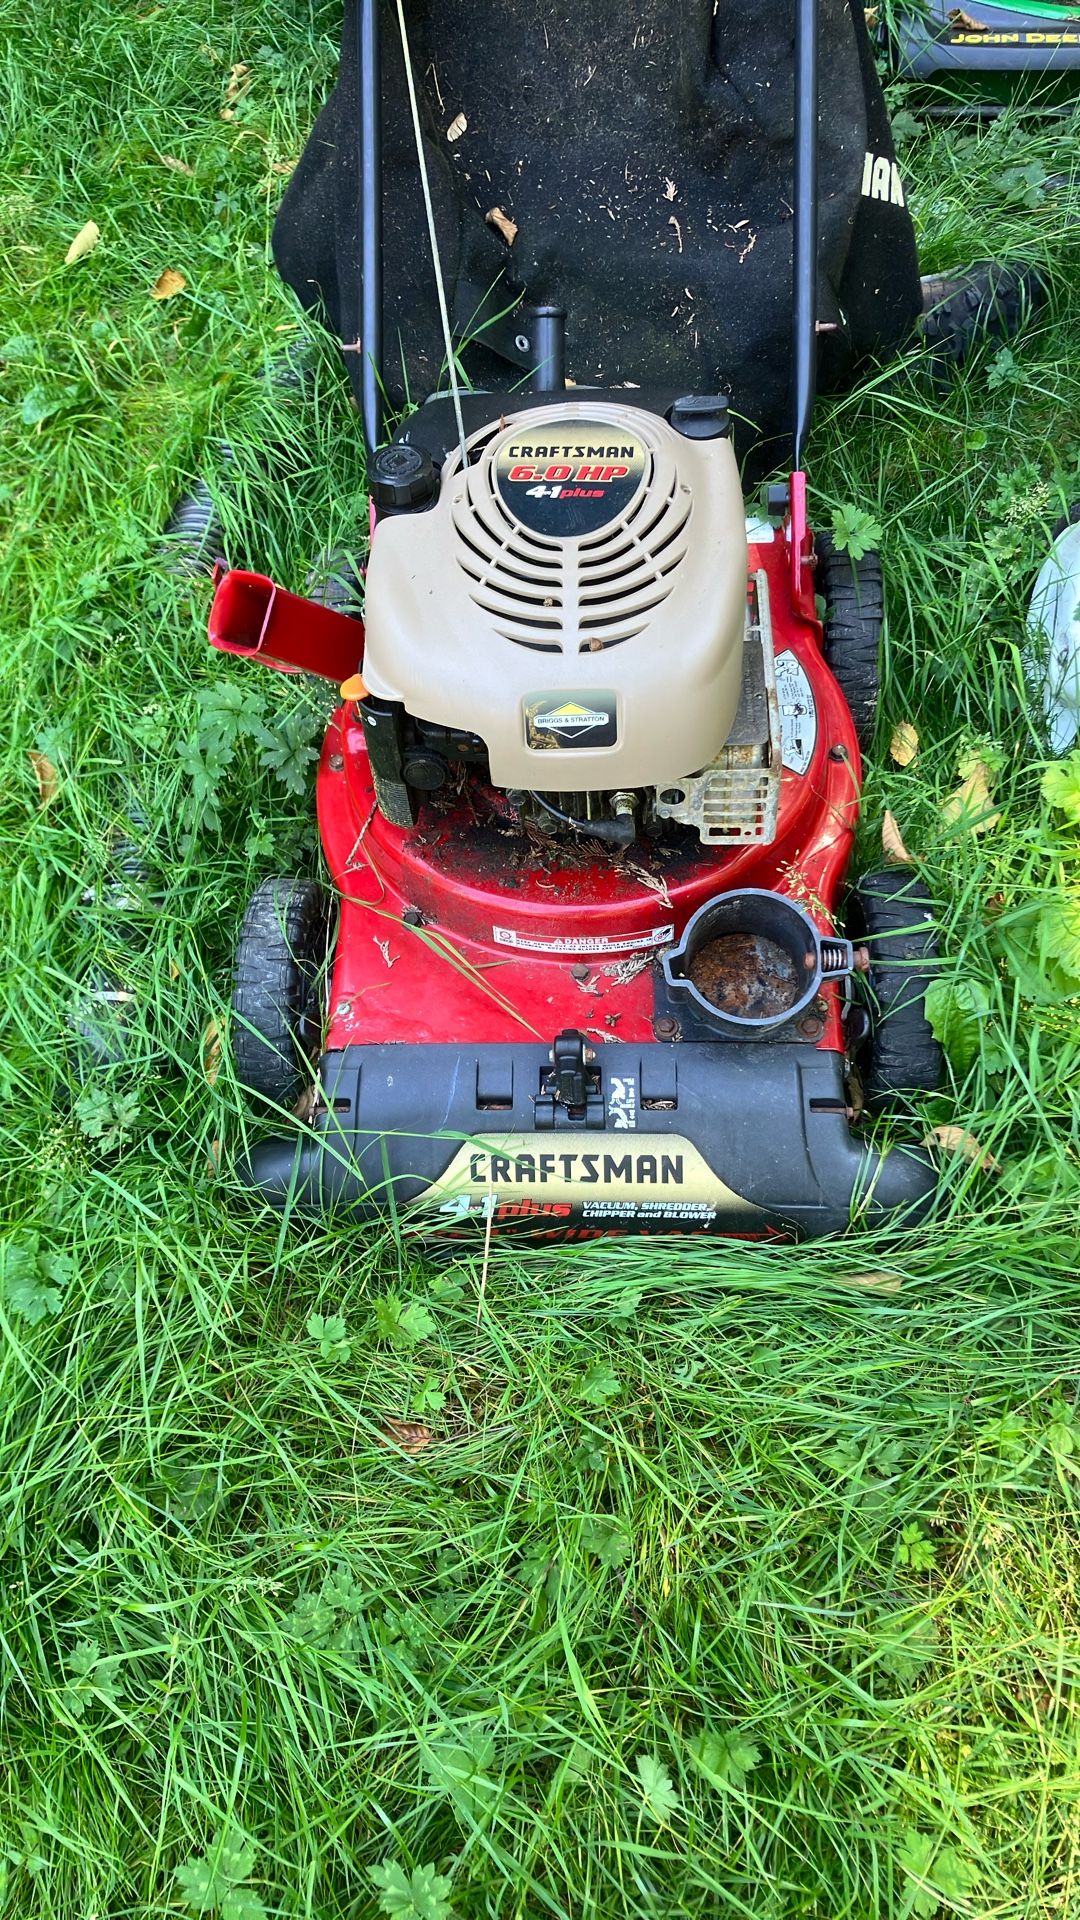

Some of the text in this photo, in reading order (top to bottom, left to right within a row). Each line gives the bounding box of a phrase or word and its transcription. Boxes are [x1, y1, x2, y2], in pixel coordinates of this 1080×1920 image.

[950, 33, 1080, 44] JOHN DEE
[509, 446, 634, 458] CRAFTSMAN
[508, 465, 629, 483] 6.0 HP
[470, 1153, 684, 1184] CRAFTSMAN
[582, 1201, 713, 1212] VACUUM, SHREDDER,
[582, 1210, 636, 1218] CHIPPER
[662, 1211, 717, 1219] BLOWER
